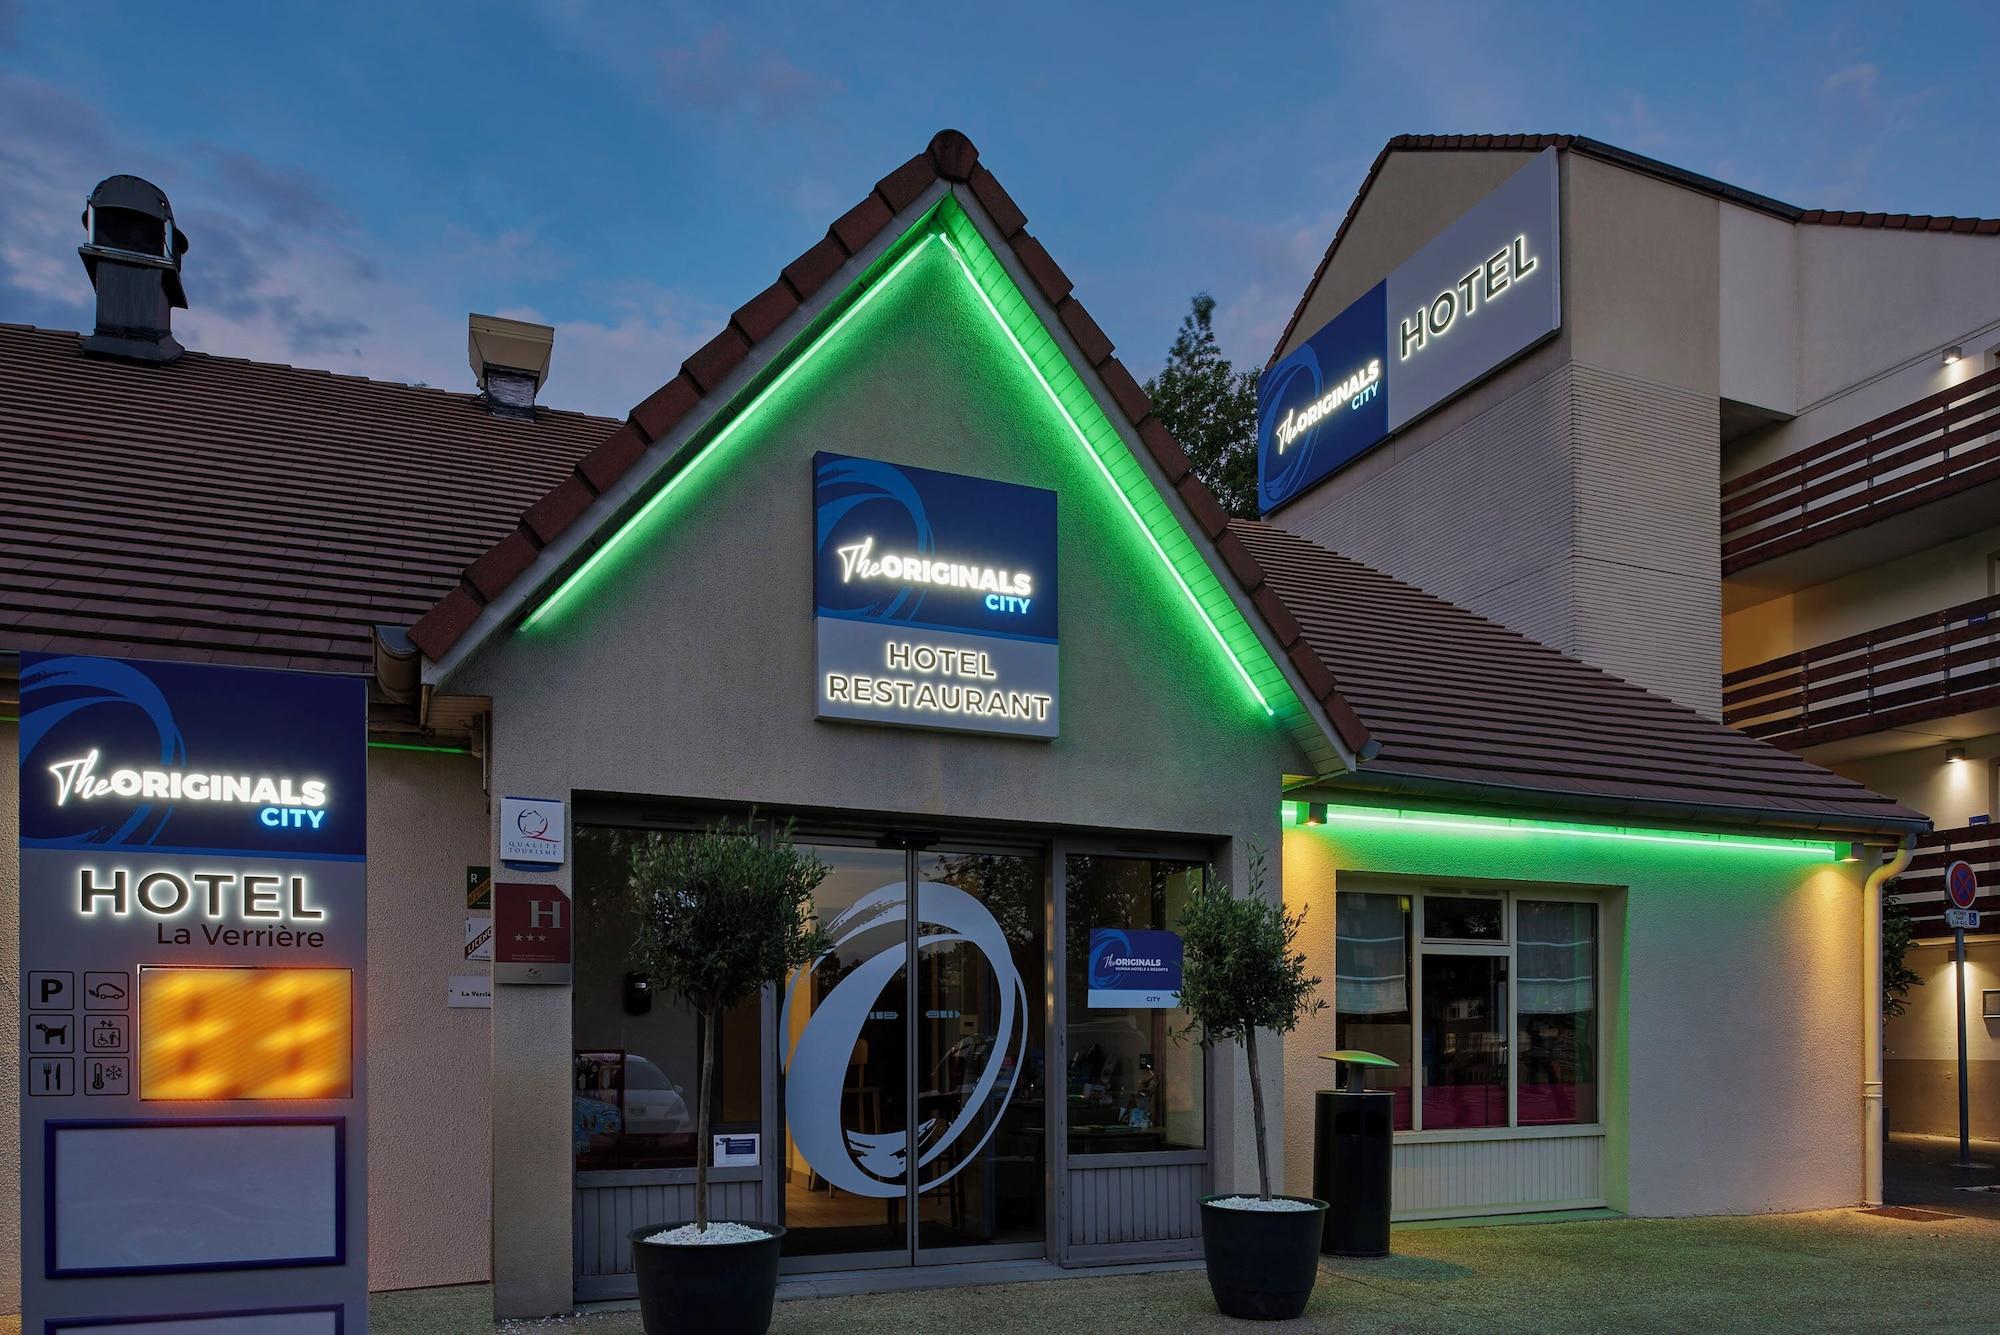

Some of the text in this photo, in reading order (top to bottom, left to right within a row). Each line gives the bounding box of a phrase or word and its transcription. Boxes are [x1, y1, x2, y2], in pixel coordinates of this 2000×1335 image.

[1401, 235, 1538, 361] HOTEL
[1352, 381, 1379, 410] CITY
[985, 595, 1031, 615] CITY
[888, 643, 996, 678] HOTEL
[828, 674, 1051, 720] RESTAURANT
[260, 807, 325, 829] CITY
[470, 873, 478, 884] R
[80, 869, 325, 921] HOTEL
[529, 900, 562, 928] H
[157, 922, 325, 948] La Verrière
